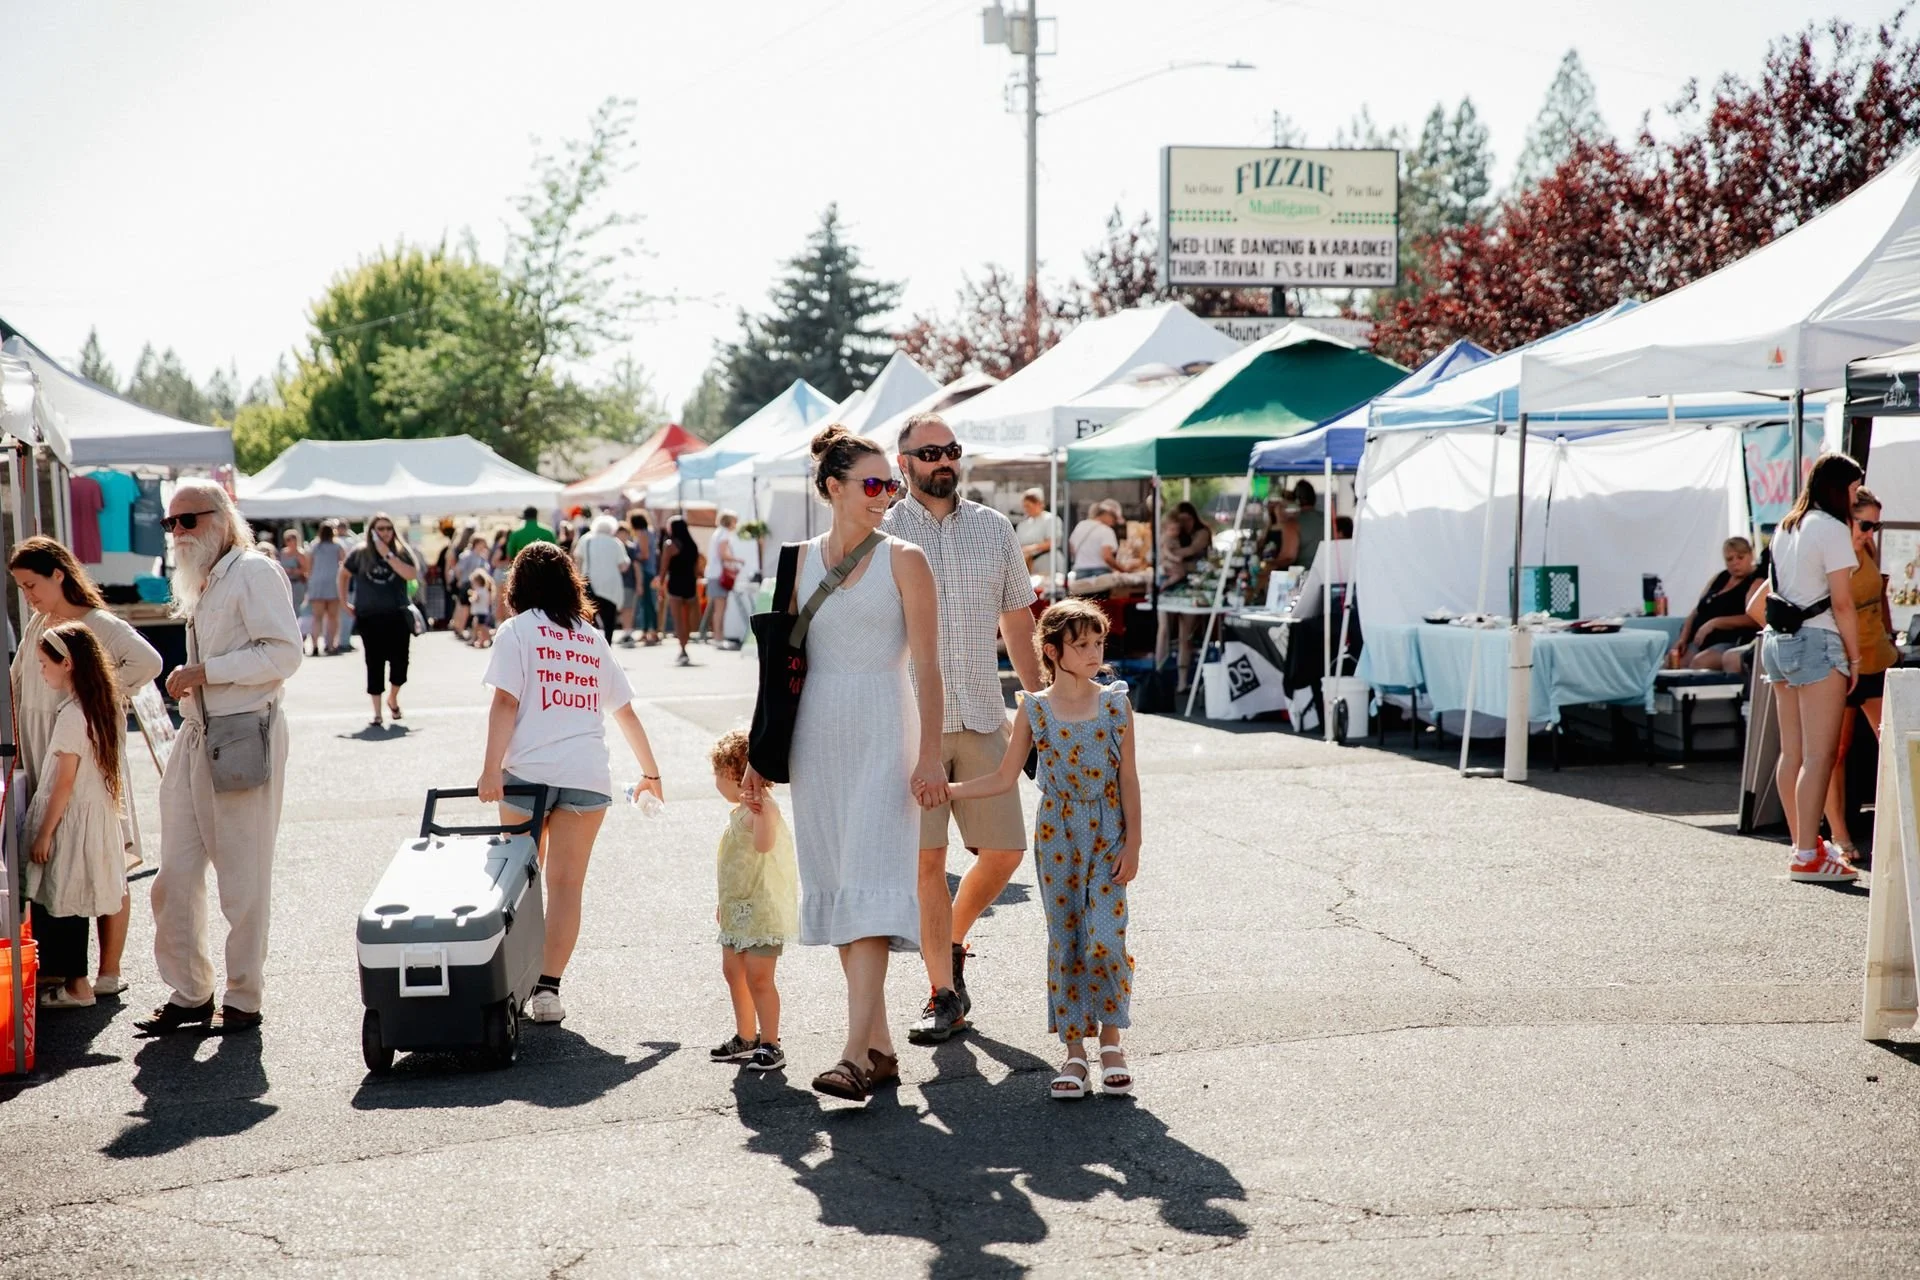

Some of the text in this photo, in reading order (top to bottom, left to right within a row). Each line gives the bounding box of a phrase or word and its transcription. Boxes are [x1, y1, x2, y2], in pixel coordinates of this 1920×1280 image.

[1236, 157, 1334, 197] FIZZIE
[1241, 239, 1304, 255] DANCING
[1308, 240, 1317, 255] &
[1321, 240, 1392, 256] KARAOKE!
[1344, 262, 1392, 278] MUSIC!
[537, 626, 594, 644] The Few
[536, 646, 600, 668] The Proud
[536, 669, 562, 683] The
